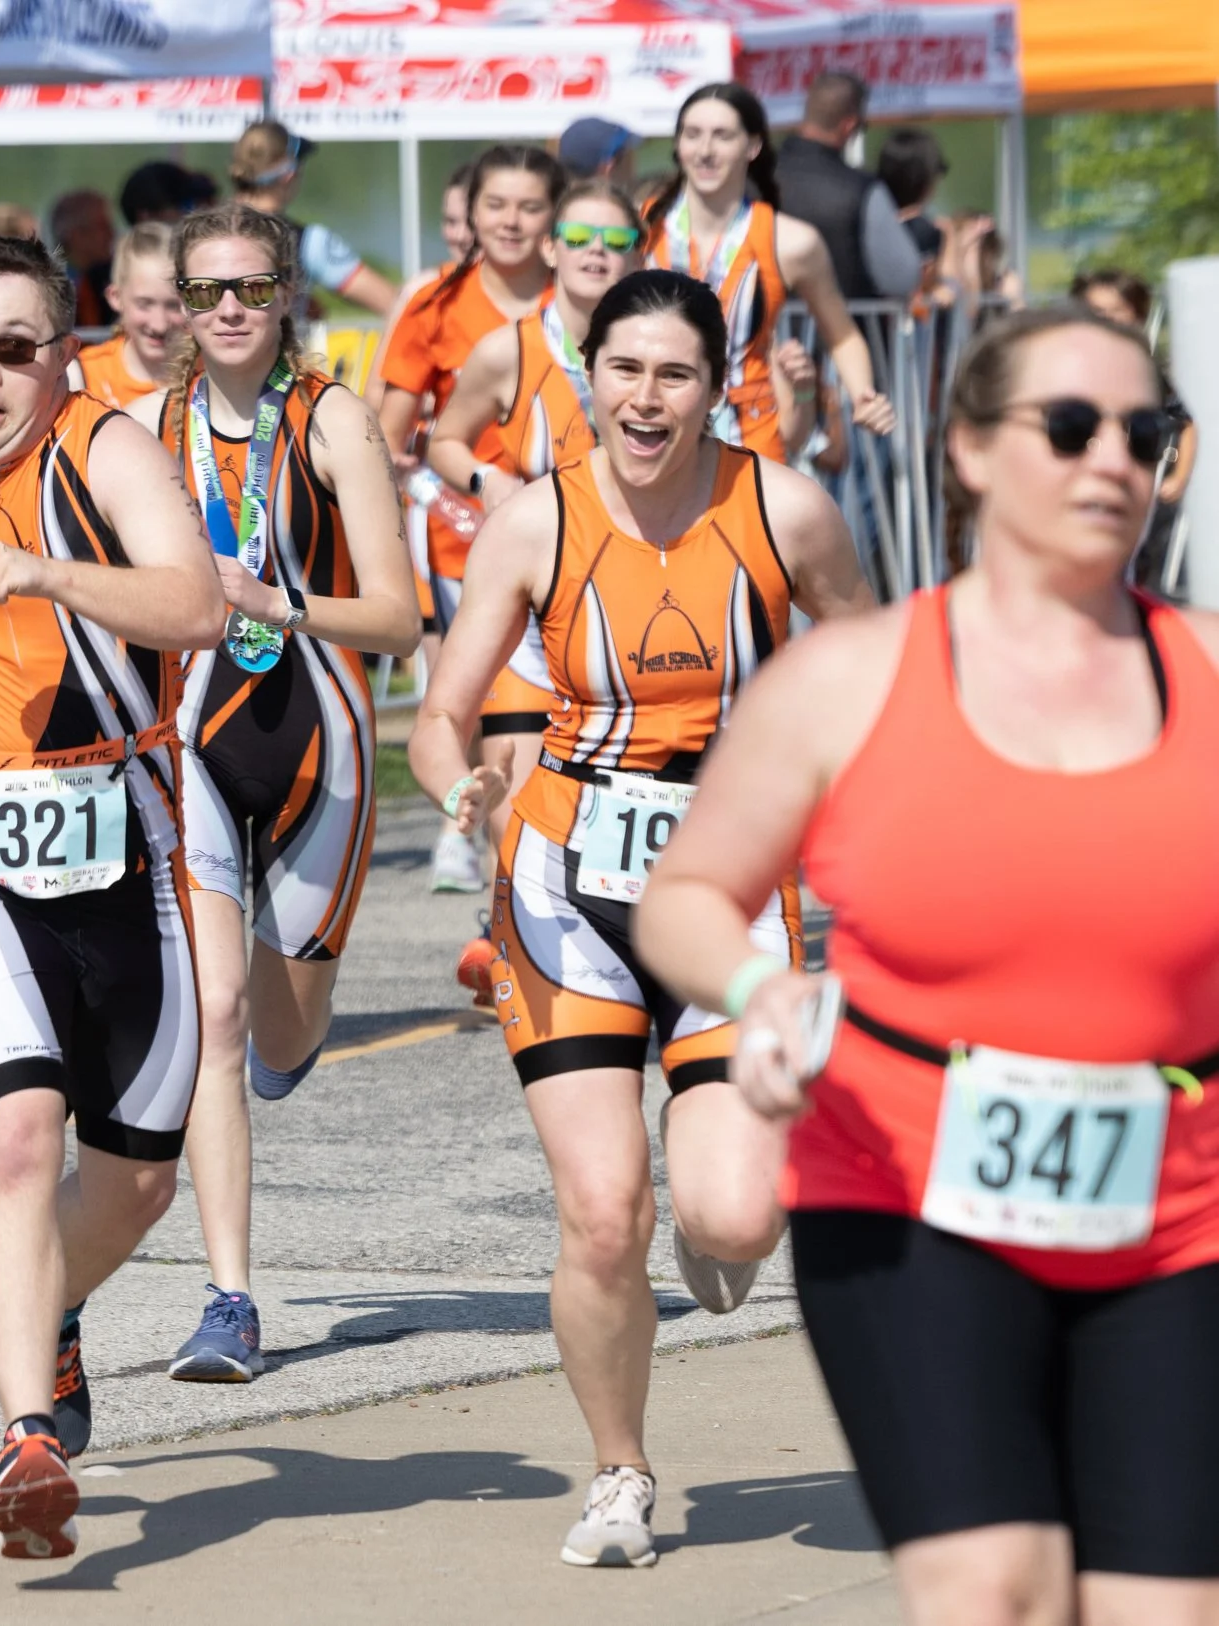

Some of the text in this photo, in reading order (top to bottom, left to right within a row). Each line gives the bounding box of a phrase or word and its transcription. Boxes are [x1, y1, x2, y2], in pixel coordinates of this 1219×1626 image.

[254, 403, 279, 443] 2023
[31, 747, 114, 769] FITLETIC
[617, 807, 681, 875] 19
[977, 1099, 1128, 1202] 347
